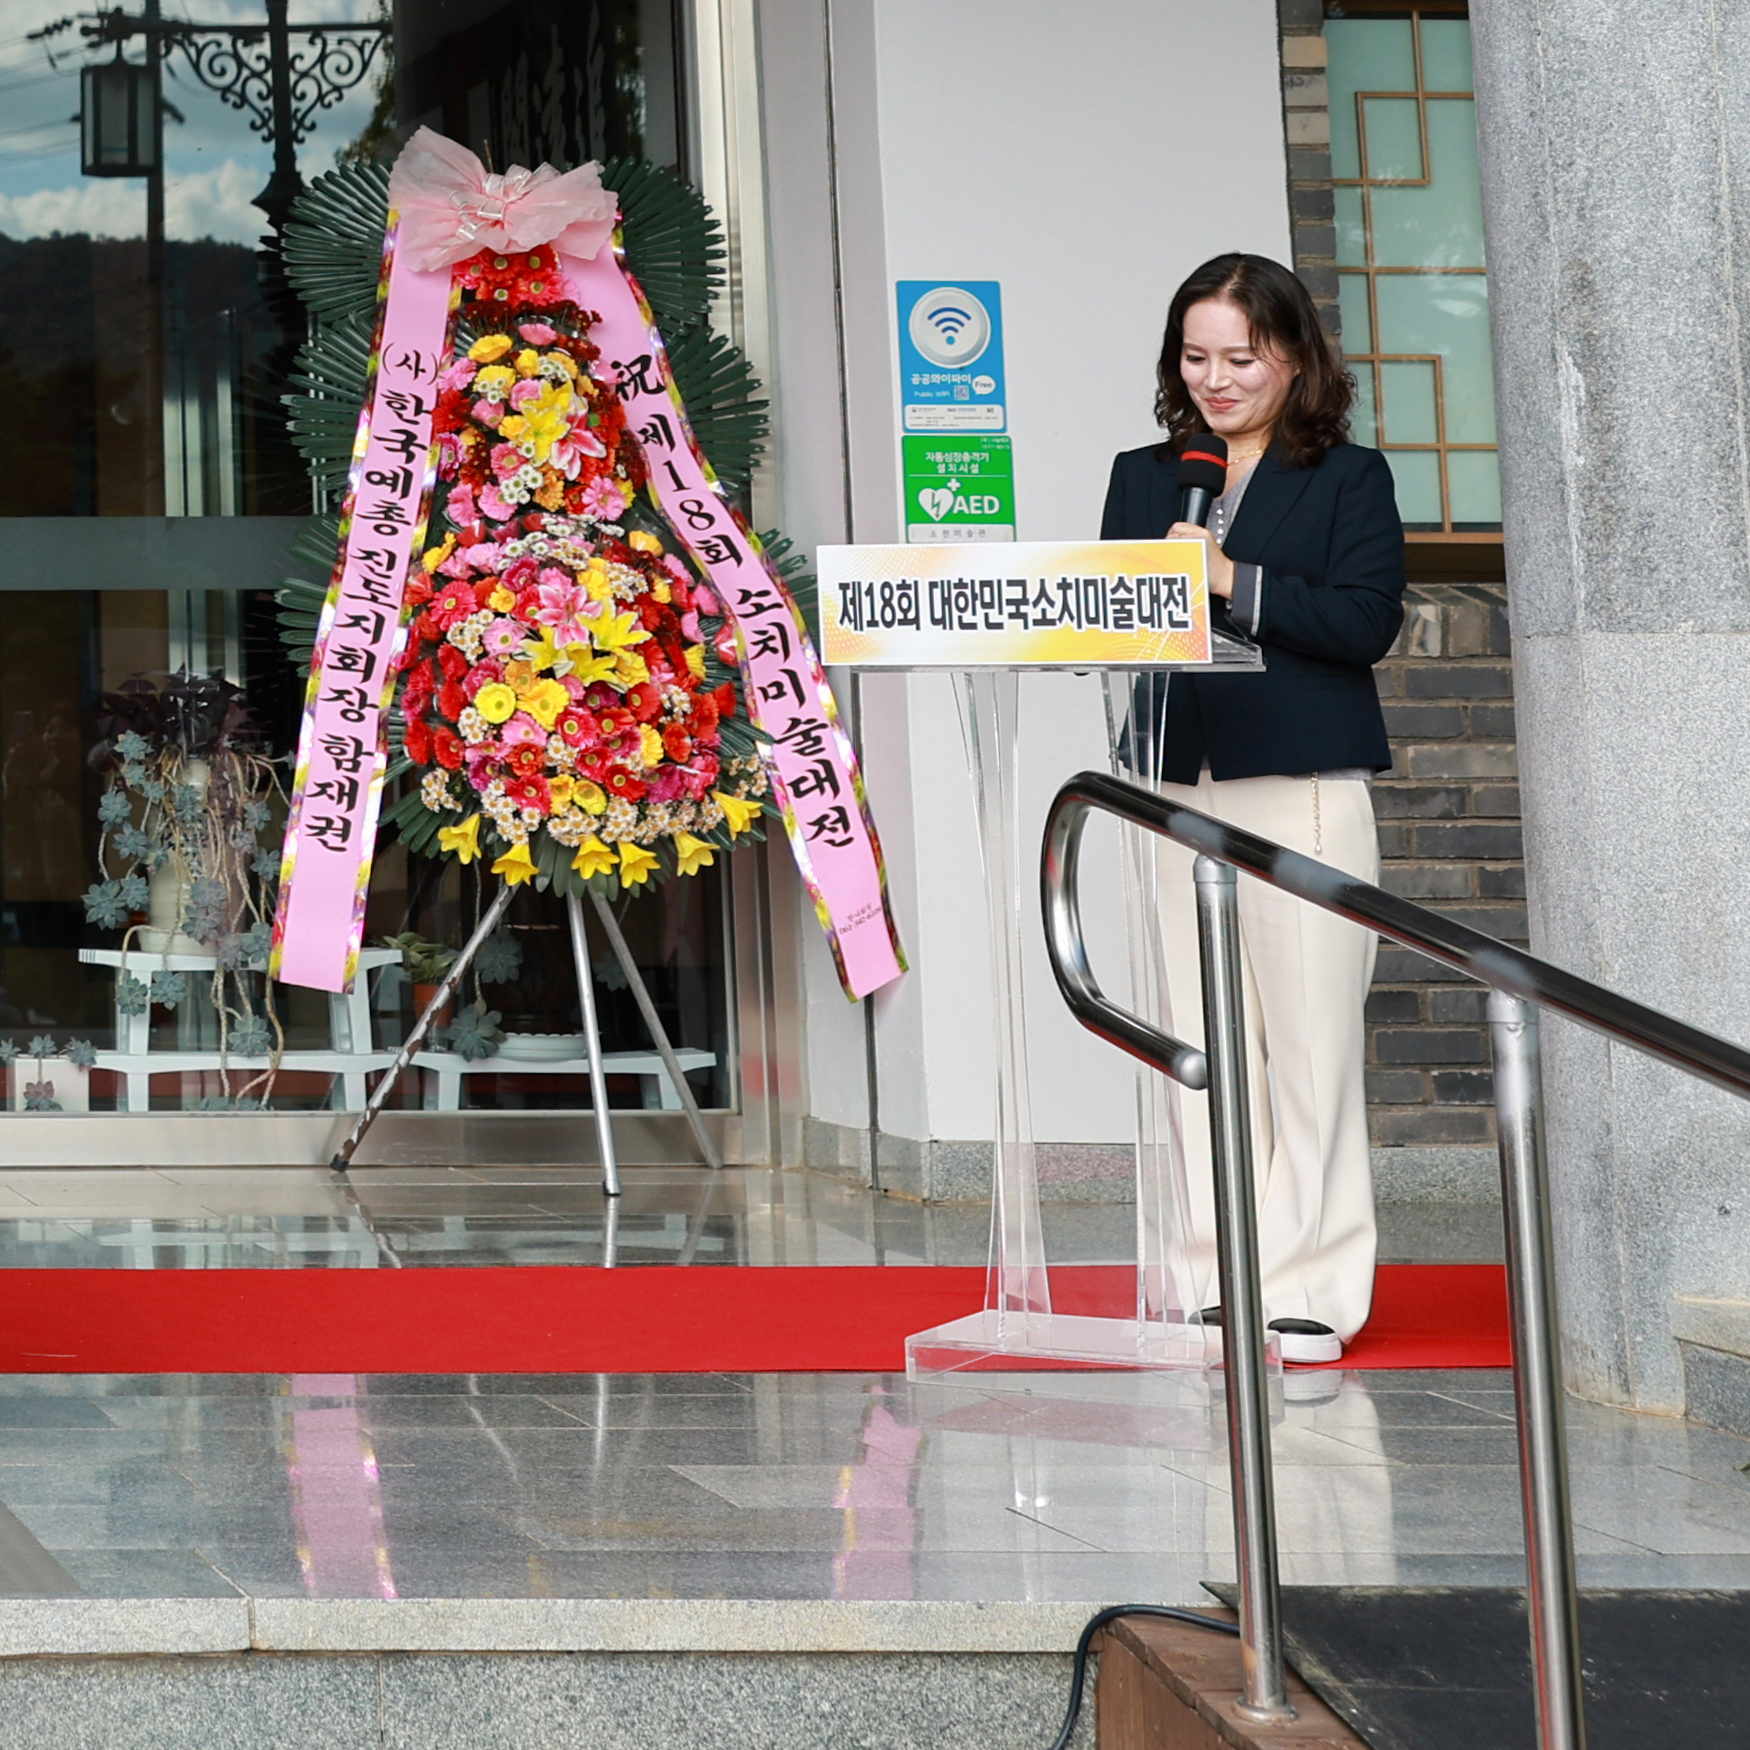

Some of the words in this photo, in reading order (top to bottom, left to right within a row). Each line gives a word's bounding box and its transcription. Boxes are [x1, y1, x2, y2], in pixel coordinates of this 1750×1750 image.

[611, 354, 666, 401] 祝
[910, 373, 972, 385] 공공와이파이
[974, 380, 993, 389] Free
[925, 451, 990, 463] 자동심장충격기
[635, 414, 743, 569] 제18회
[953, 495, 1000, 515] AED
[838, 579, 922, 632] 제18회
[928, 576, 1192, 631] 대한민국소치미술대전
[319, 548, 399, 724] 진도지회장
[736, 588, 855, 848] 소치미술대전
[305, 732, 375, 852] 함재권
